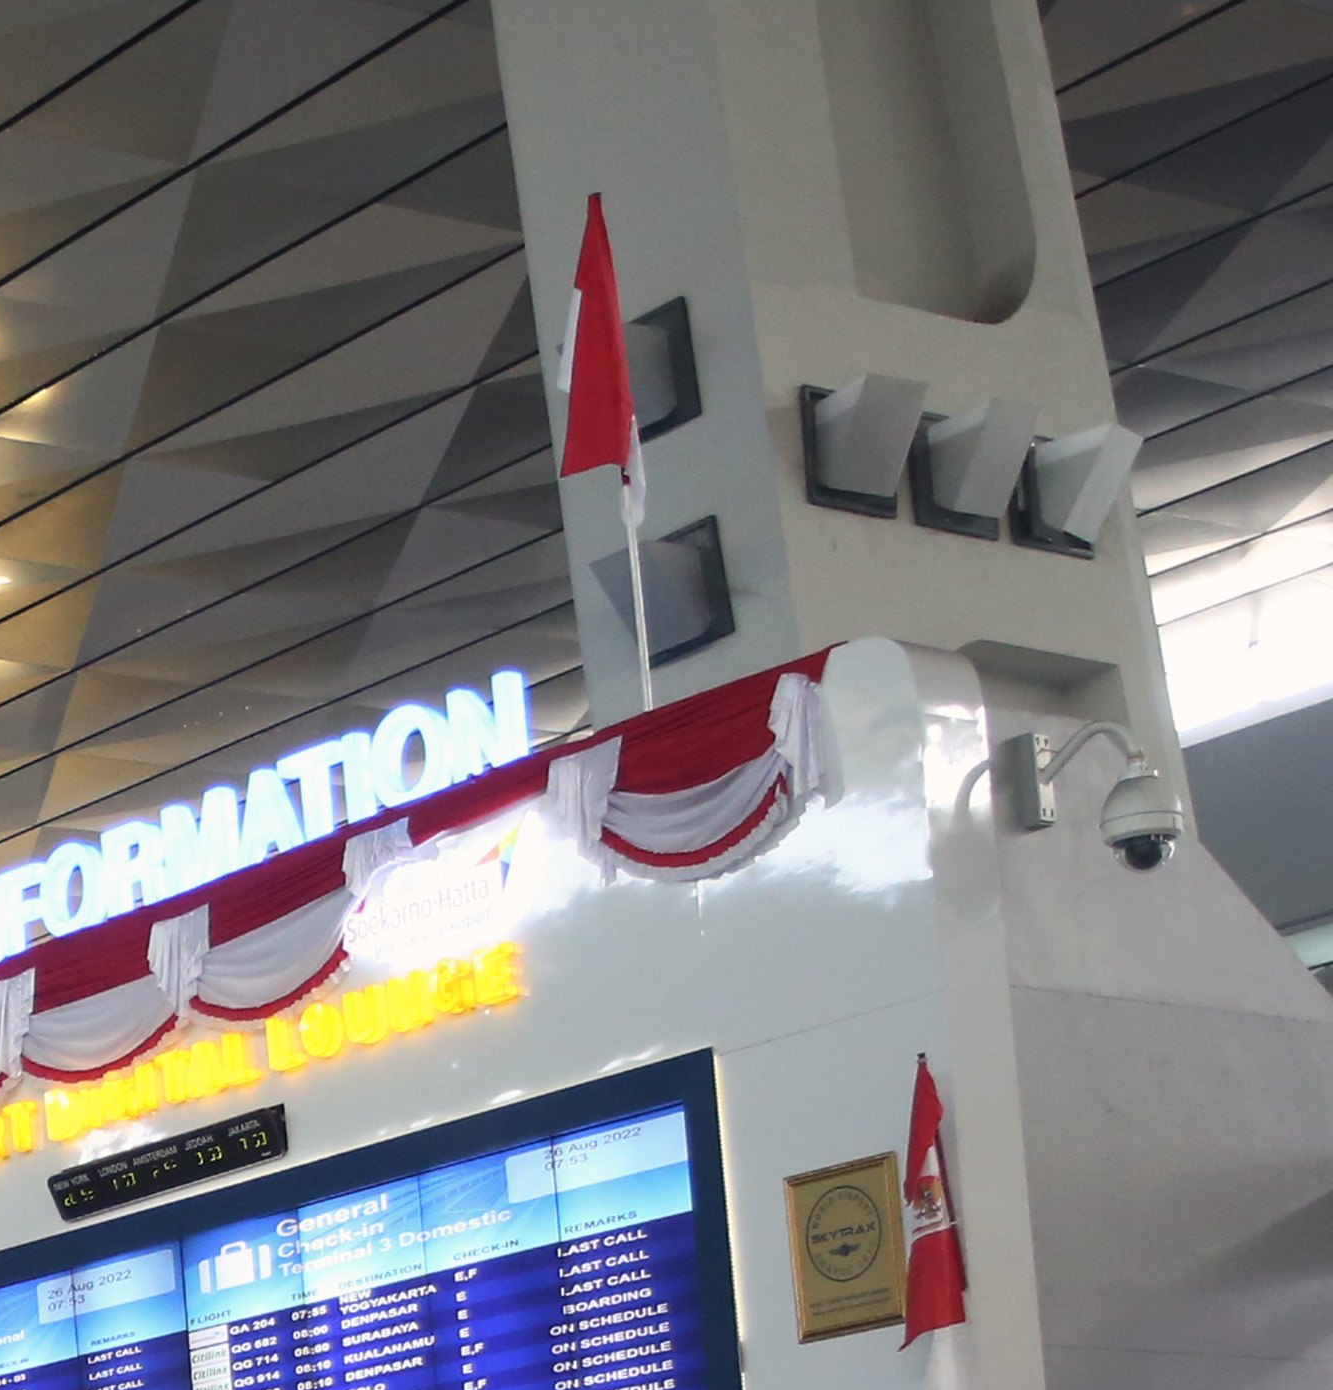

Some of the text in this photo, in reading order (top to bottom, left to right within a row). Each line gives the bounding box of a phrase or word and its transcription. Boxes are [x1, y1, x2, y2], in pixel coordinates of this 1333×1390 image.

[347, 878, 490, 943] Soekarno-Hatta
[43, 1031, 262, 1142] DIGITAL
[264, 942, 525, 1073] LOUNGE
[52, 1180, 70, 1193] NEW
[70, 1173, 90, 1187] YORK
[97, 1160, 129, 1178] LONDON
[132, 1145, 179, 1167] AMSTERDAM
[184, 1133, 215, 1151] JEDDAH
[227, 1119, 261, 1138] JAKARTA
[542, 1123, 643, 1161] 26 Aug 2022
[543, 1150, 588, 1173] 07:53
[274, 1191, 388, 1240] General
[563, 1208, 638, 1237] REMARKS
[276, 1217, 385, 1261] Check-in
[277, 1204, 513, 1278] Terminal 3 Domestic
[557, 1229, 647, 1257] LAST CALL
[811, 1221, 877, 1245] SKYTRAX
[452, 1237, 521, 1263] CHECK-IN
[46, 1267, 132, 1301] 26 Aug 2022
[337, 1260, 423, 1291] DESTINATION
[454, 1267, 477, 1282] E,F
[47, 1292, 86, 1313] 07:53
[290, 1285, 320, 1302] TIME
[339, 1284, 437, 1315] YOGYAKARTA
[340, 1291, 370, 1304] NEW
[562, 1287, 652, 1315] BOARDING
[189, 1306, 233, 1326] FLIGHT
[229, 1316, 276, 1335] GA 204
[291, 1304, 327, 1321] 07:55
[458, 1327, 469, 1338] E
[551, 1321, 670, 1354] ON SCHEDULE
[87, 1345, 141, 1364] LAST CALL
[343, 1335, 435, 1364] KUALANAMU
[233, 1370, 280, 1388] QG 914
[295, 1359, 332, 1374] 08:10
